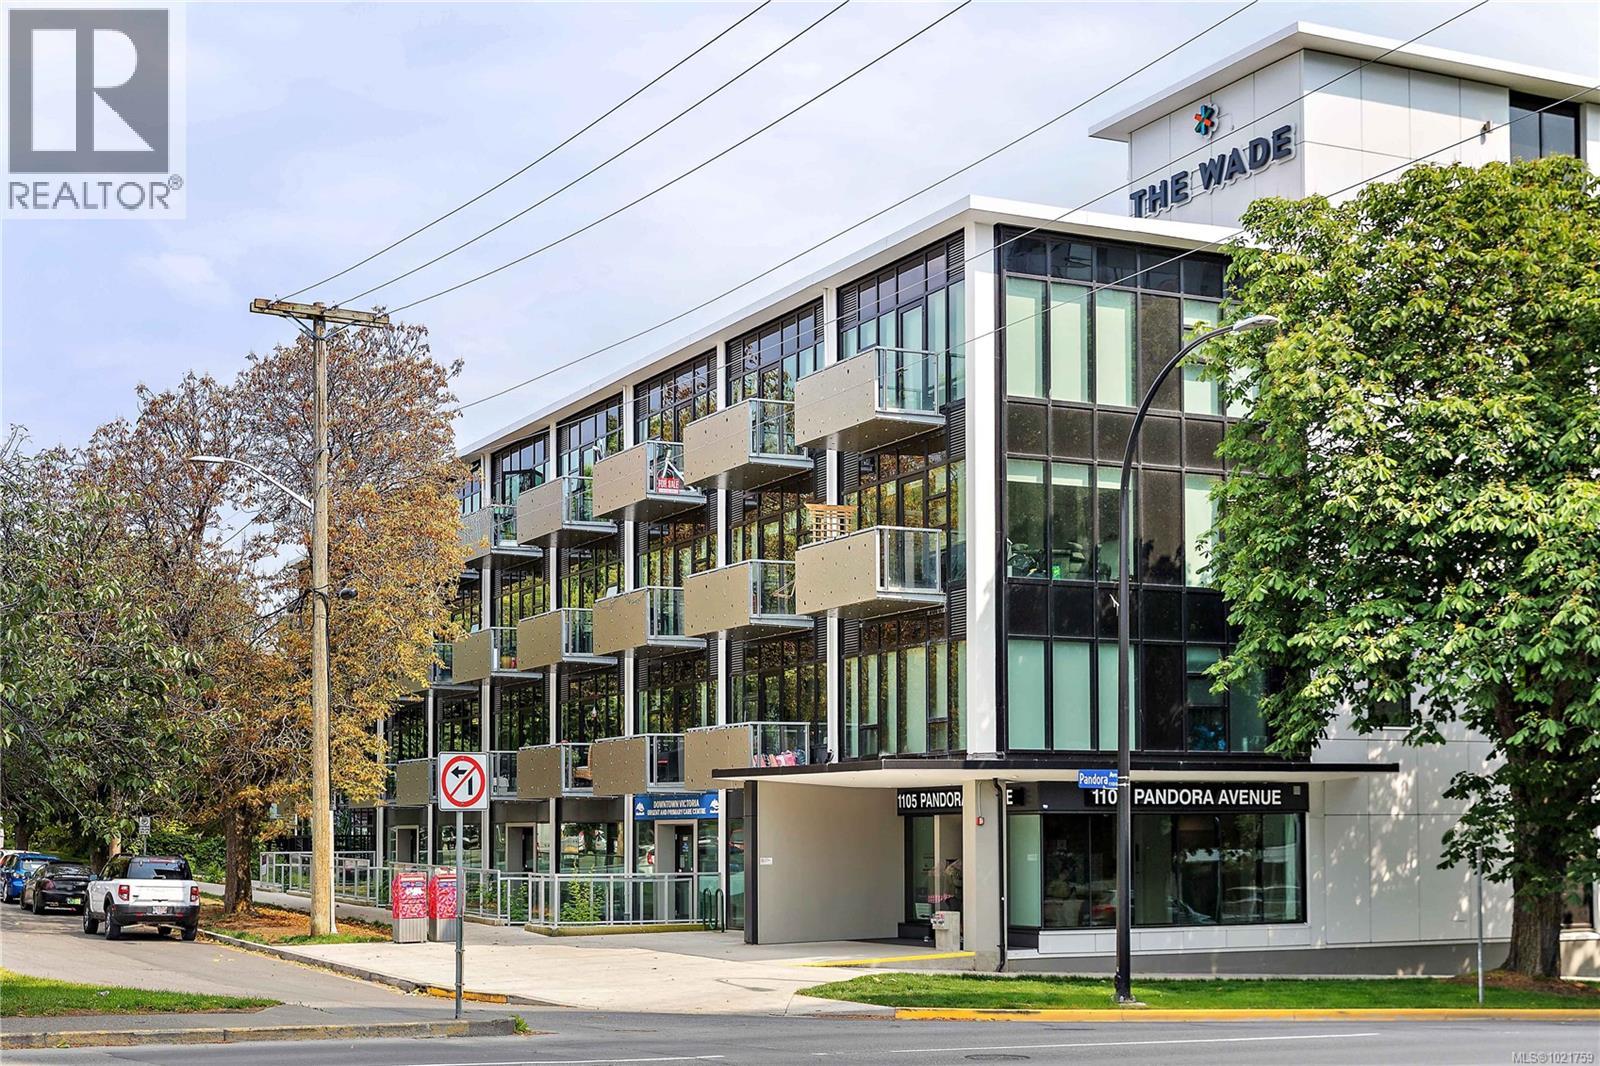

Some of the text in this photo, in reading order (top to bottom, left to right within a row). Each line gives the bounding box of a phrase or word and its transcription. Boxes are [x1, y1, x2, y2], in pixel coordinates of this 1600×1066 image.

[1129, 124, 1293, 218] THE WADE
[657, 479, 679, 488] FOR SALE
[1079, 773, 1109, 785] Pandora
[897, 791, 964, 809] 1105 PANDOR
[1092, 788, 1282, 806] 110 PANDORA AVENUE
